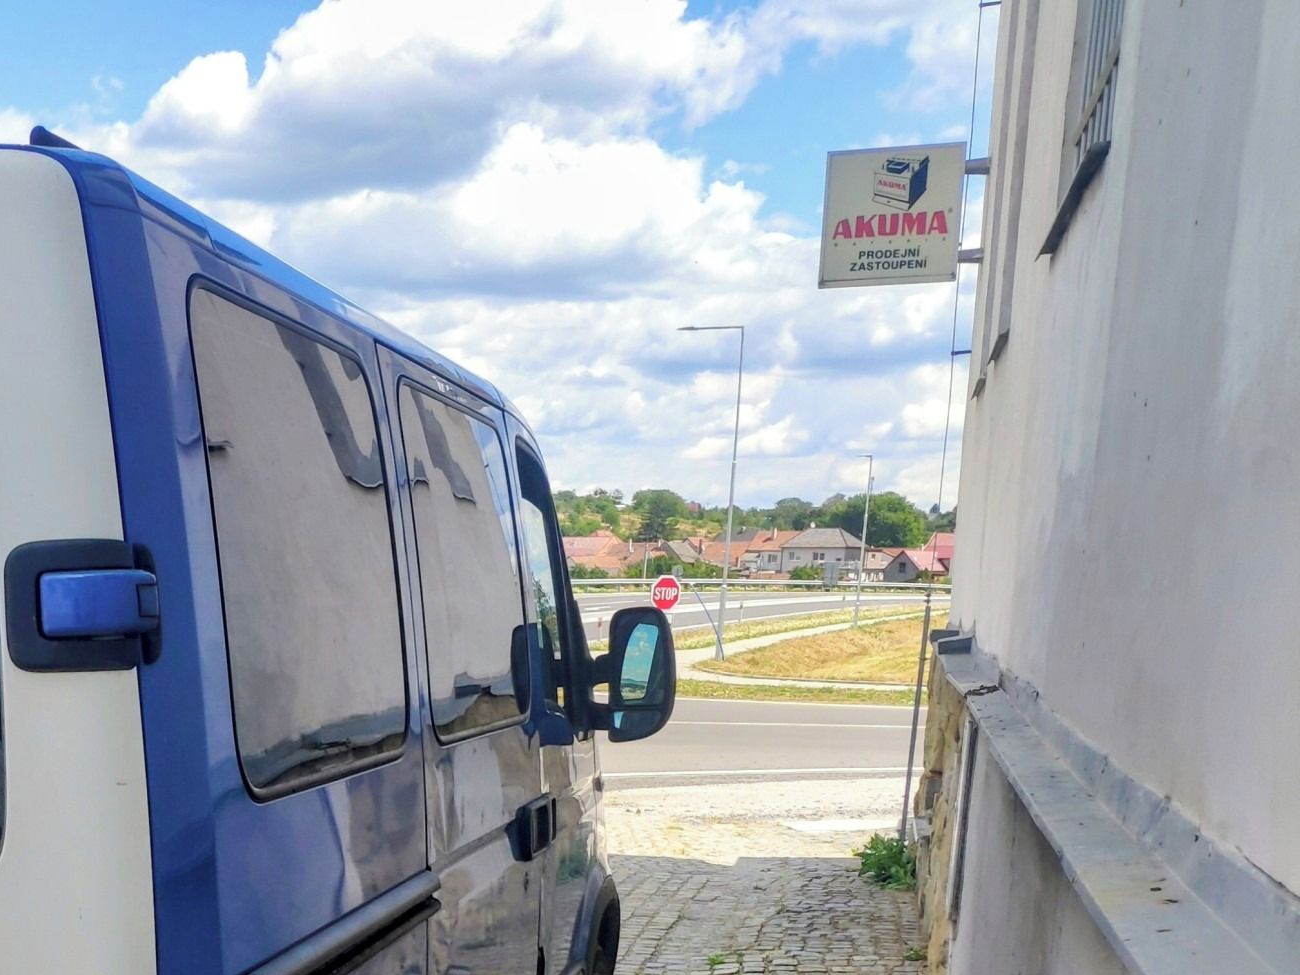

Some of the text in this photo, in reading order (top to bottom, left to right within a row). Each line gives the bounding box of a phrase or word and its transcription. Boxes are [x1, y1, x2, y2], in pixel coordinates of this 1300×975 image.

[832, 210, 948, 240] AKUMA
[858, 245, 921, 260] PRODEJNÍ
[850, 259, 927, 272] ZASTOUPENÍ
[654, 587, 678, 601] STOP
